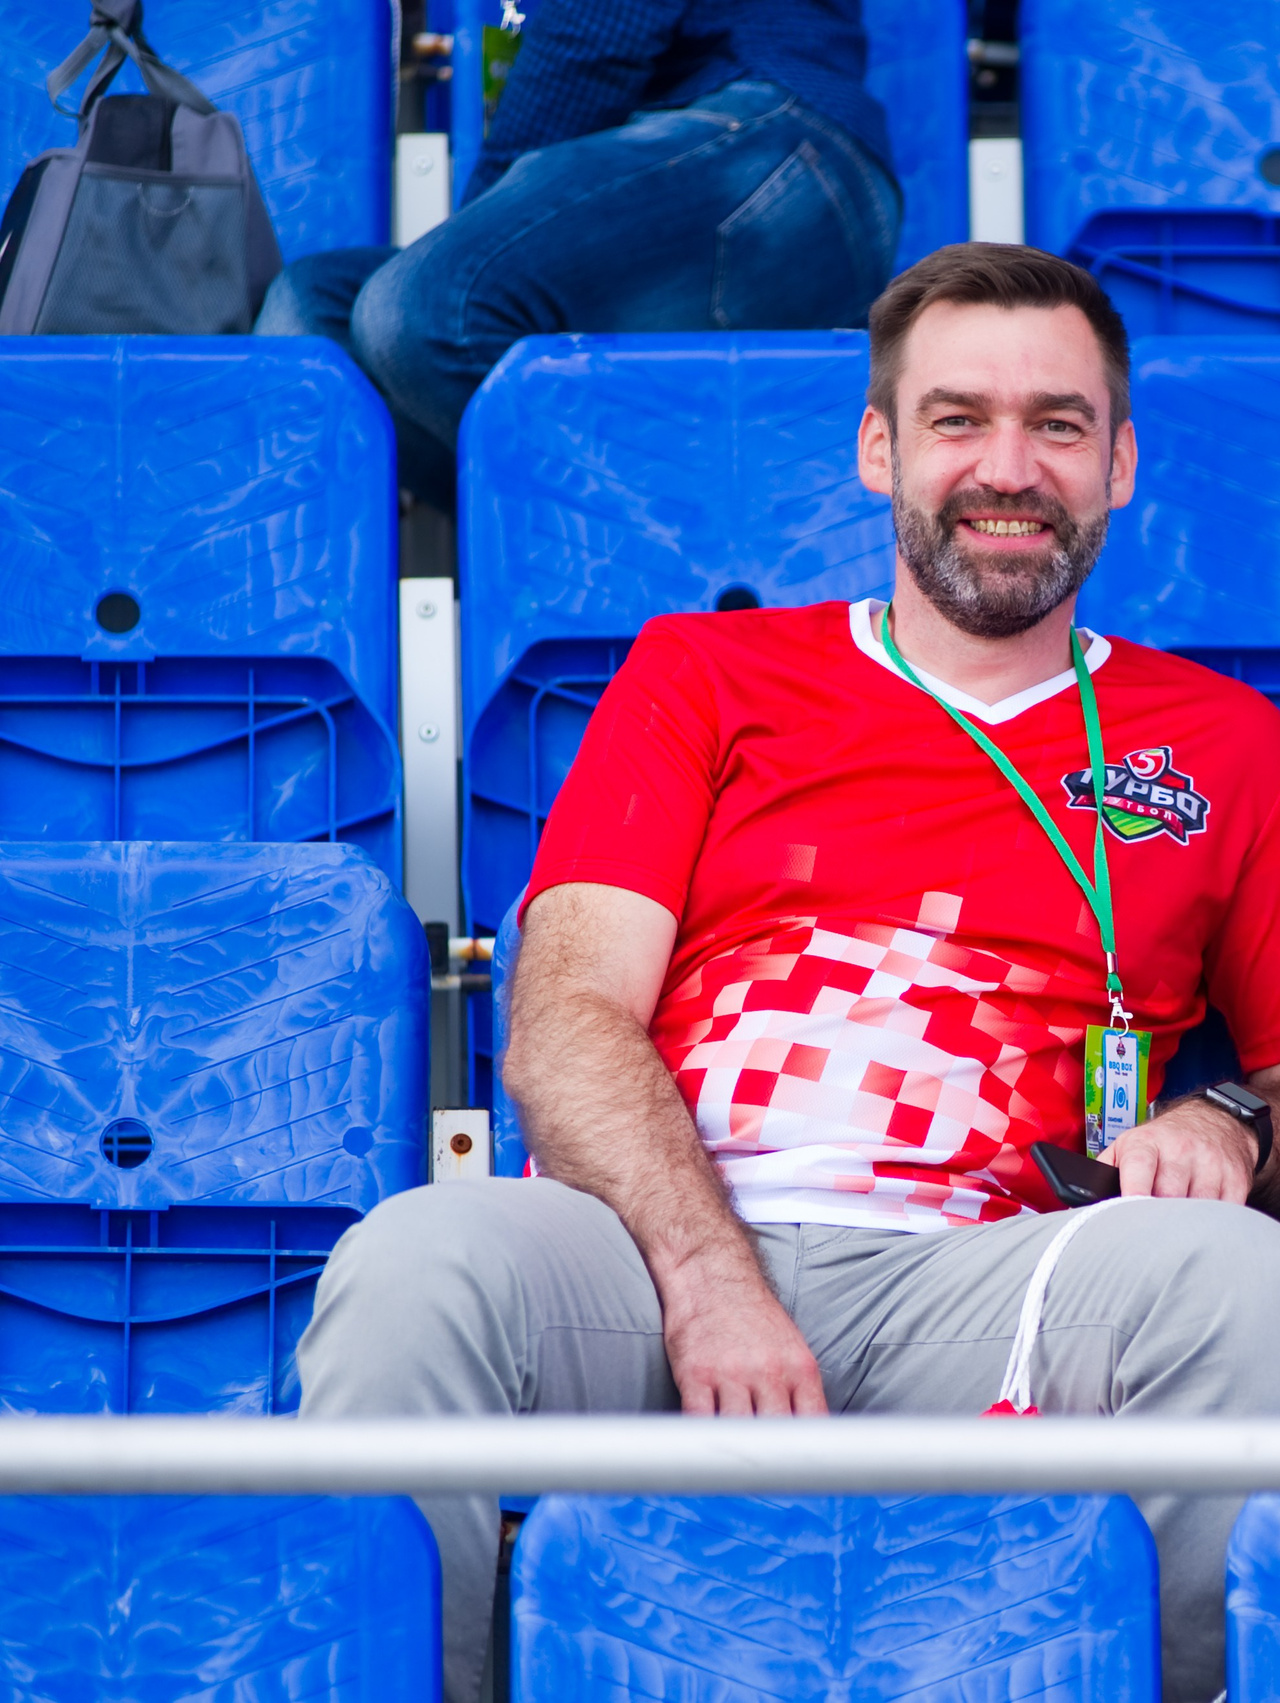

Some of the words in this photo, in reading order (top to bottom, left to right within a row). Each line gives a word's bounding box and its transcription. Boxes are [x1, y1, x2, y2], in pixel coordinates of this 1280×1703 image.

[1134, 753, 1155, 774] 5
[1102, 796, 1173, 821] УТБОЛ
[1109, 1061, 1120, 1071] BBQ
[1121, 1063, 1132, 1071] BOX
